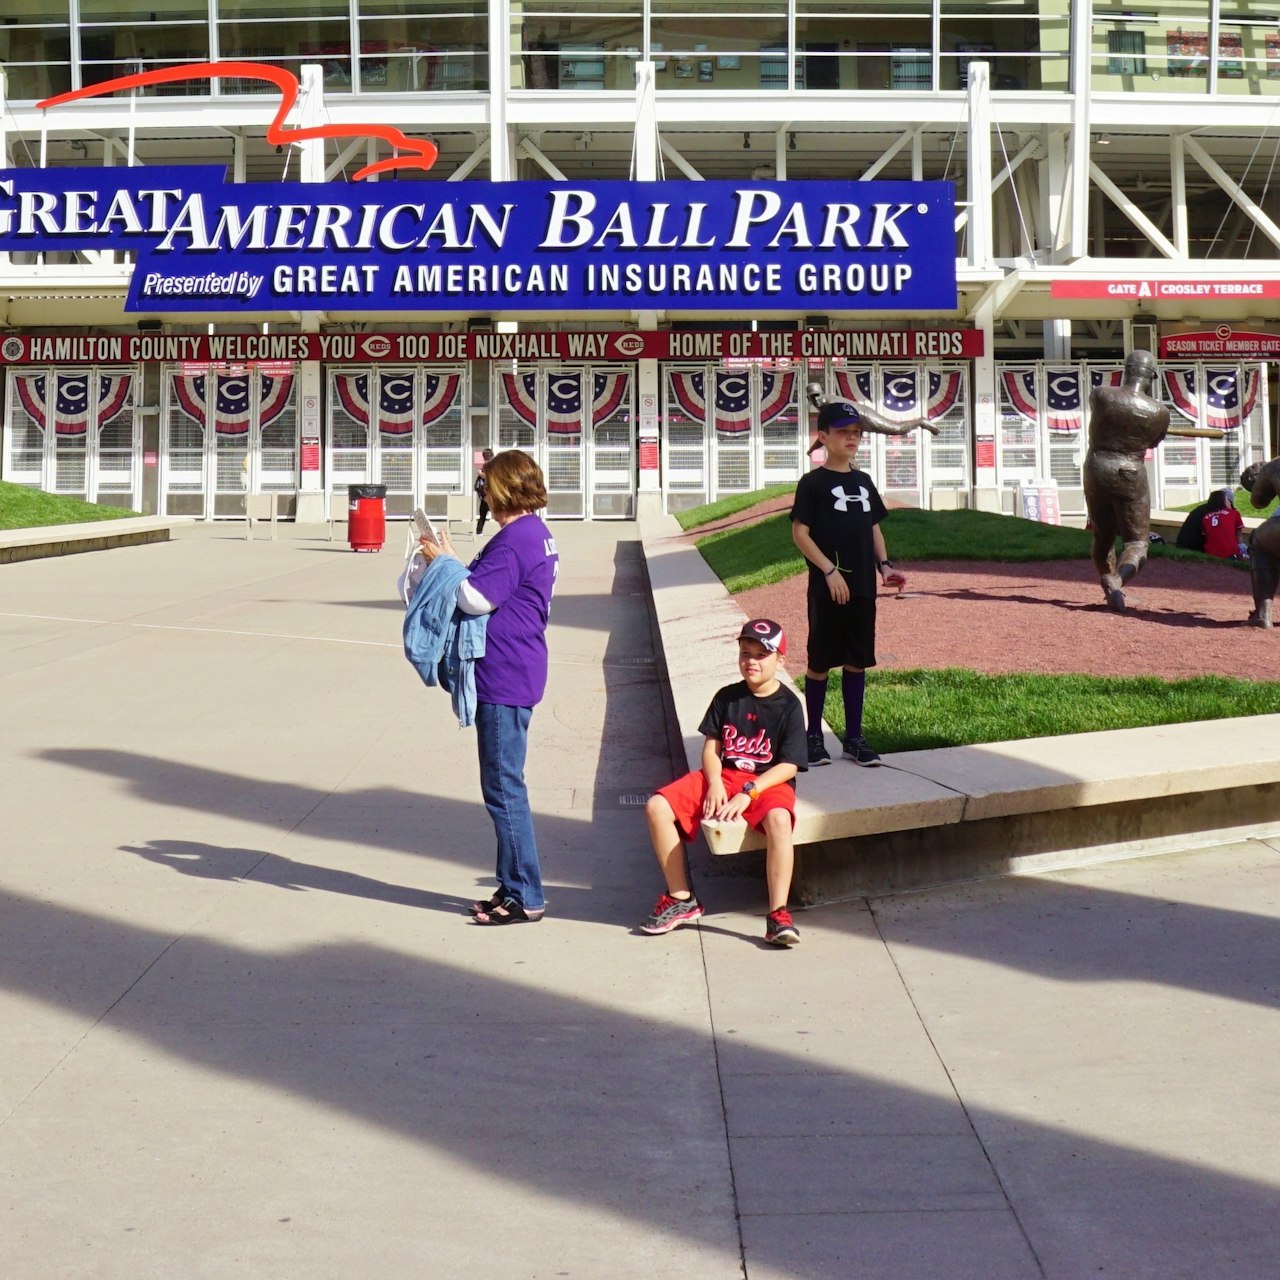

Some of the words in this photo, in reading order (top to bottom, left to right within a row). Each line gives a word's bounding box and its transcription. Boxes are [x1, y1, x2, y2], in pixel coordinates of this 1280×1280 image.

[156, 191, 517, 251] AMERICAN
[538, 188, 719, 249] BALL
[142, 272, 235, 297] Presented
[234, 272, 265, 299] by
[273, 264, 380, 294] GREAT
[393, 263, 569, 294] AMERICAN
[587, 263, 783, 293] INSURANCE
[799, 263, 913, 292] GROUP
[1108, 283, 1137, 295] GATE
[1138, 281, 1152, 297] A
[1161, 283, 1211, 295] CROSLEY
[1213, 283, 1264, 295] TERRACE
[30, 337, 122, 361] HAMILTON
[129, 336, 202, 361] COUNTY
[209, 335, 310, 360] WELCOMES
[319, 335, 356, 359] YOU
[396, 334, 430, 359] 100
[436, 334, 467, 359] JOE
[475, 333, 561, 358] NUXHALL
[568, 333, 609, 358] WAY
[669, 332, 723, 357] HOME
[729, 332, 752, 357] OF
[760, 332, 794, 357] THE
[801, 331, 909, 356] CINCINNATI
[915, 331, 963, 356] REDS
[1166, 340, 1197, 352] SEASON
[1198, 340, 1225, 352] TICKET
[1226, 340, 1260, 352] MEMBER
[1261, 340, 1280, 352] GATE
[722, 724, 772, 757] Reds
